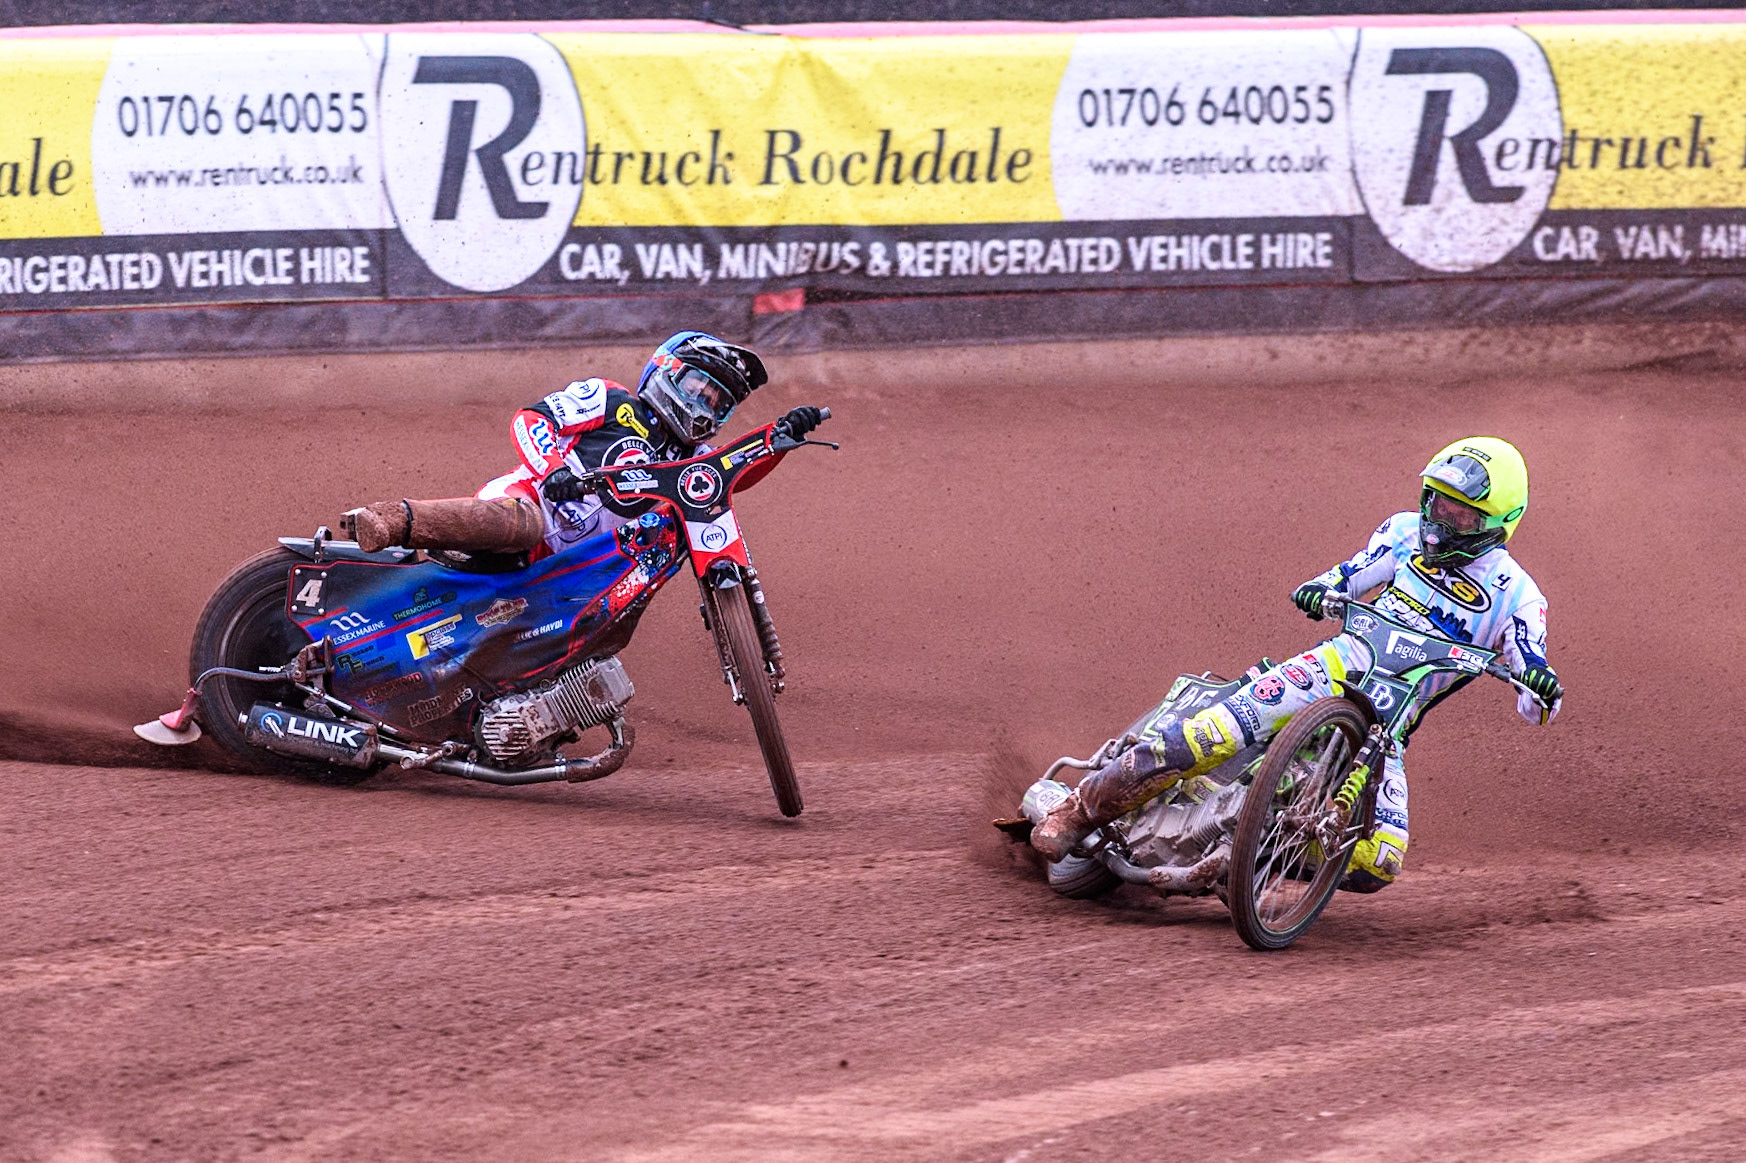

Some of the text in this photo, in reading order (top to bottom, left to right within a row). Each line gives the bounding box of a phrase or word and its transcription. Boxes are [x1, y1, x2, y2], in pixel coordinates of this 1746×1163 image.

[118, 92, 368, 137] 01706 640055
[1078, 84, 1335, 128] 01706 640055
[759, 126, 1034, 187] Rochdale
[1087, 148, 1330, 178] www.rentruck.co.uk
[129, 160, 364, 189] www.rentruck.co.uk
[168, 246, 295, 290] VEHICLE
[300, 245, 371, 285] HIRE
[559, 231, 1335, 287] CAR, VAN, MINIBUS & REFRIGERATED VEHICLE HIRE
[705, 532, 725, 544] ATPI
[295, 578, 323, 608] 4
[333, 630, 357, 646] ESSEX
[1394, 643, 1428, 662] agilia
[287, 716, 362, 748] LINK
